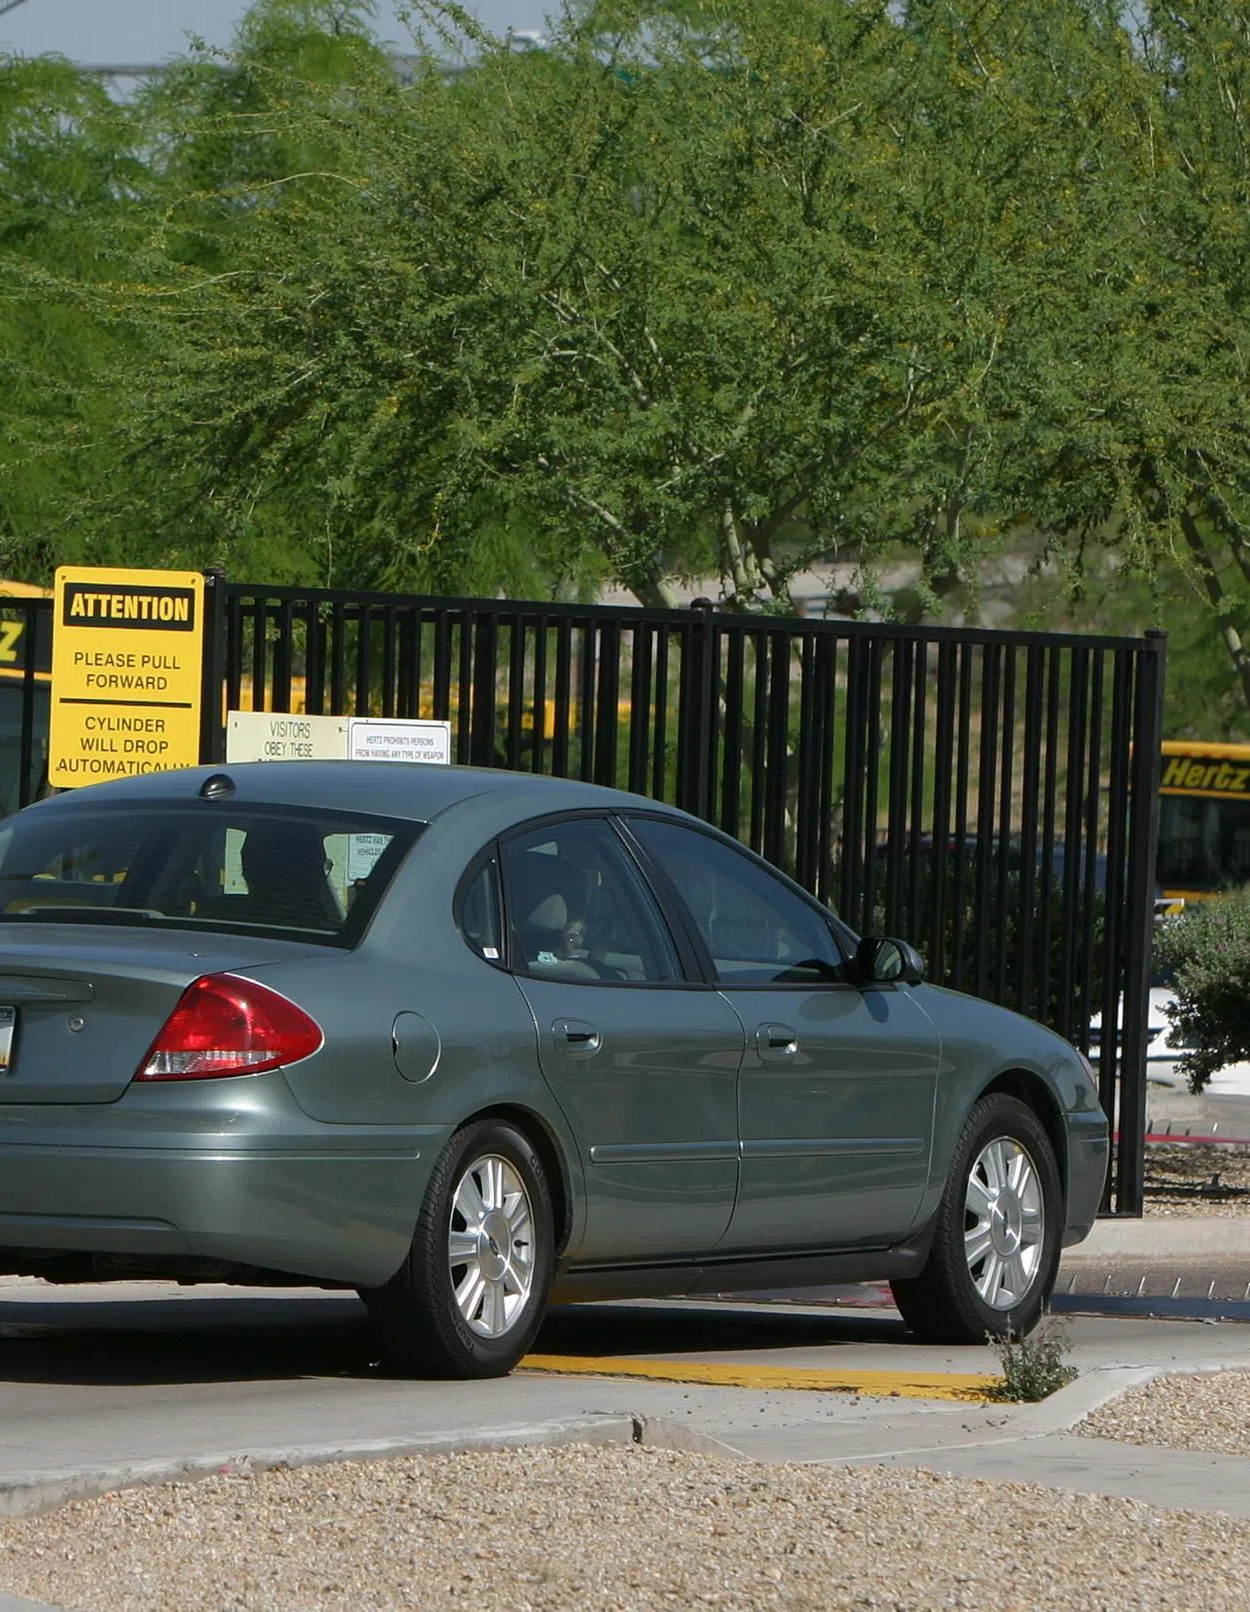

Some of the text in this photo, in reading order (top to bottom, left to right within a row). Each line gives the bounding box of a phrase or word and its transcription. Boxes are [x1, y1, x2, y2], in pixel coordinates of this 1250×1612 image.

[70, 593, 189, 621] ATTENTION
[74, 652, 181, 669] PLEASE PULL
[86, 674, 168, 690] FORWARD
[85, 717, 166, 733] CYLINDER
[269, 721, 311, 739] VISITORS
[80, 737, 169, 754] WILL DROP
[264, 741, 313, 757] OBEY THESE
[366, 735, 382, 745] HERTZ
[410, 737, 435, 747] PERSONS
[355, 748, 444, 760] FROM HAVING ANY TYPE OF WEAPON
[1161, 758, 1249, 790] Hertz
